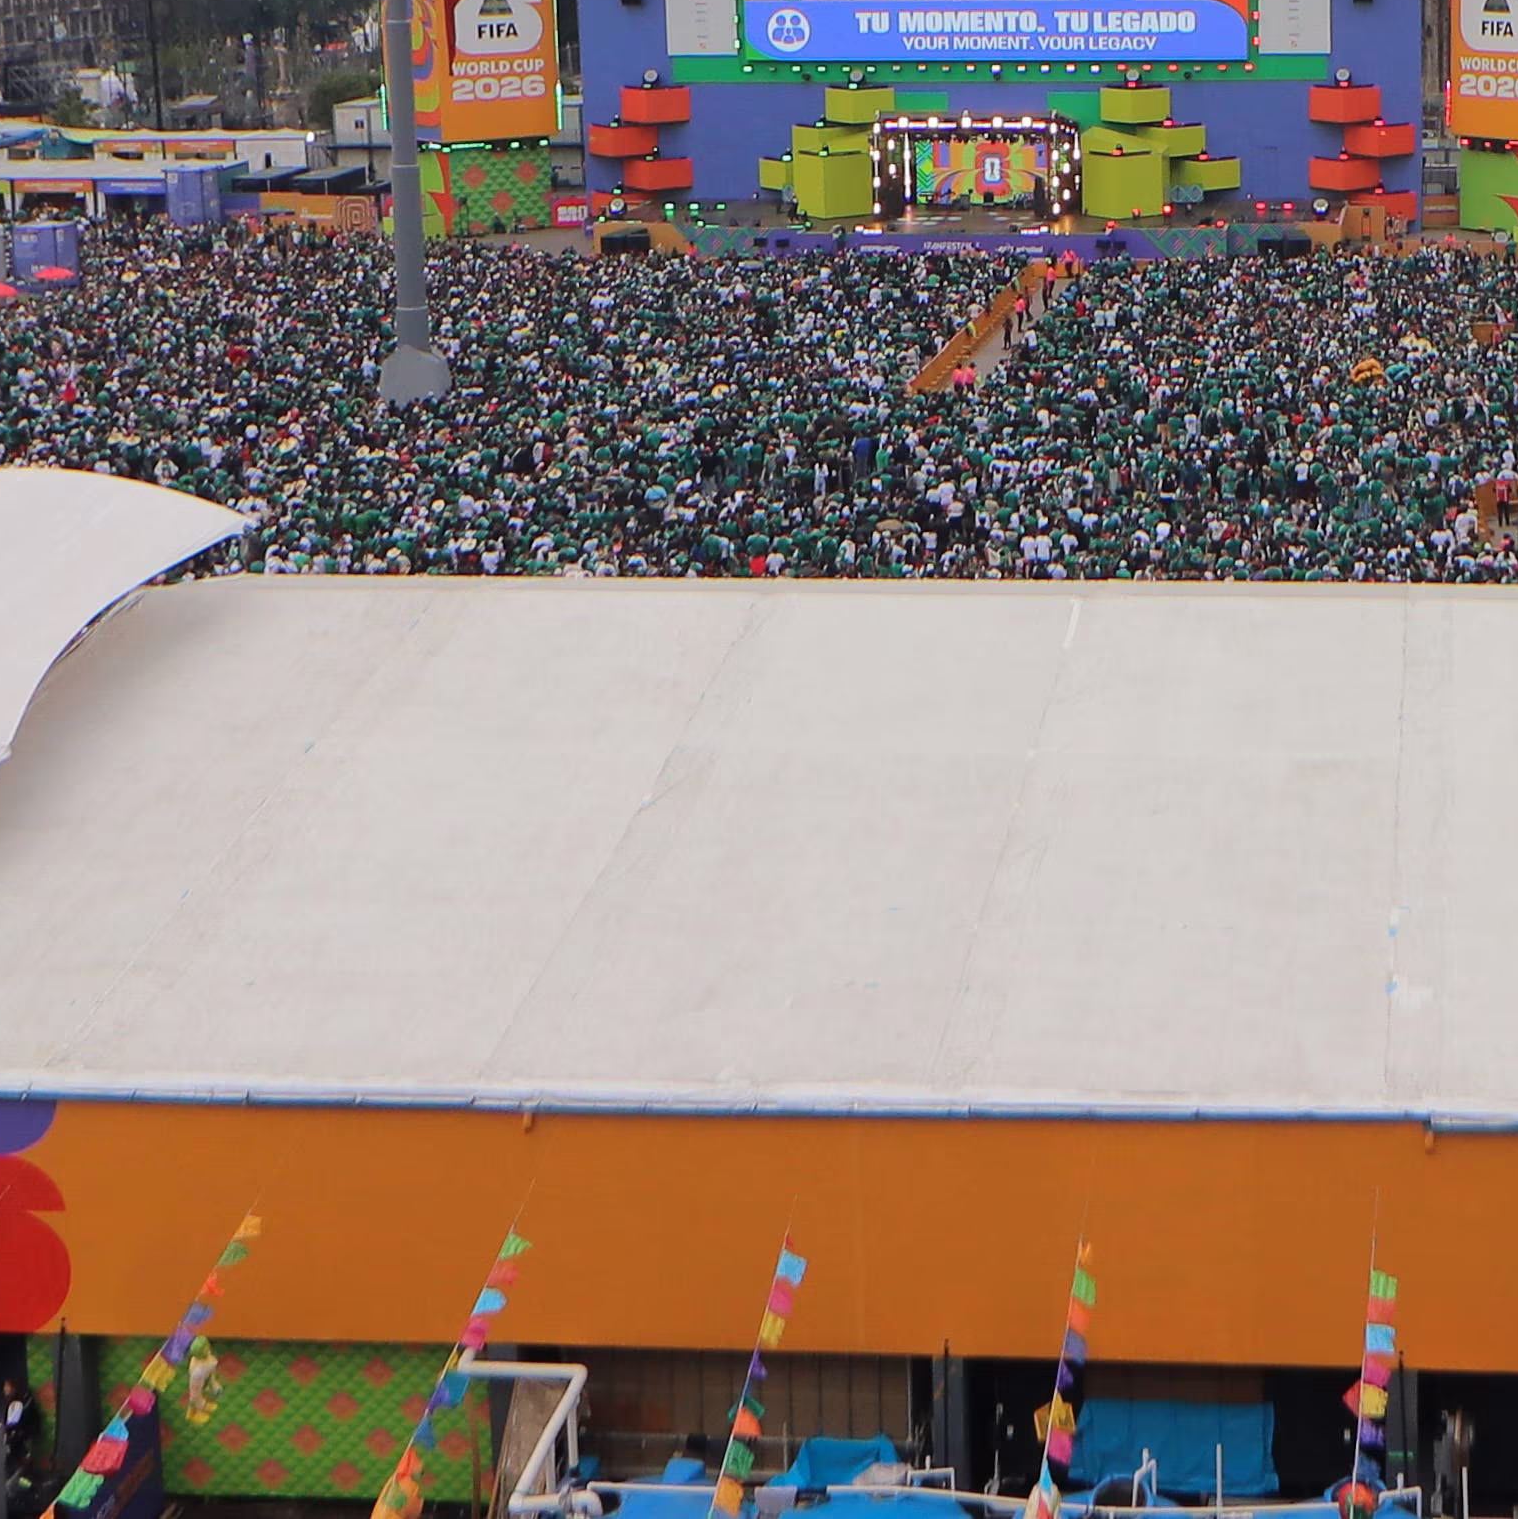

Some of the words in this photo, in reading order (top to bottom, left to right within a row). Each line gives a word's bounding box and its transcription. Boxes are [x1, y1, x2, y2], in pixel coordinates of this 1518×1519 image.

[855, 10, 890, 33] TU
[898, 10, 1046, 33] MOMENTO.
[1053, 10, 1090, 33] TU
[1093, 10, 1196, 33] LEGADO
[1481, 21, 1513, 37] FIFA
[477, 22, 518, 39] FIFA
[902, 36, 951, 51] YOUR
[953, 36, 1035, 51] MOMENT.
[1037, 36, 1086, 51] YOUR
[1088, 36, 1157, 51] LEGACY
[452, 60, 511, 77] WORLD
[513, 58, 545, 73] CUP
[1459, 56, 1507, 72] WORLD
[452, 75, 546, 100] 2026
